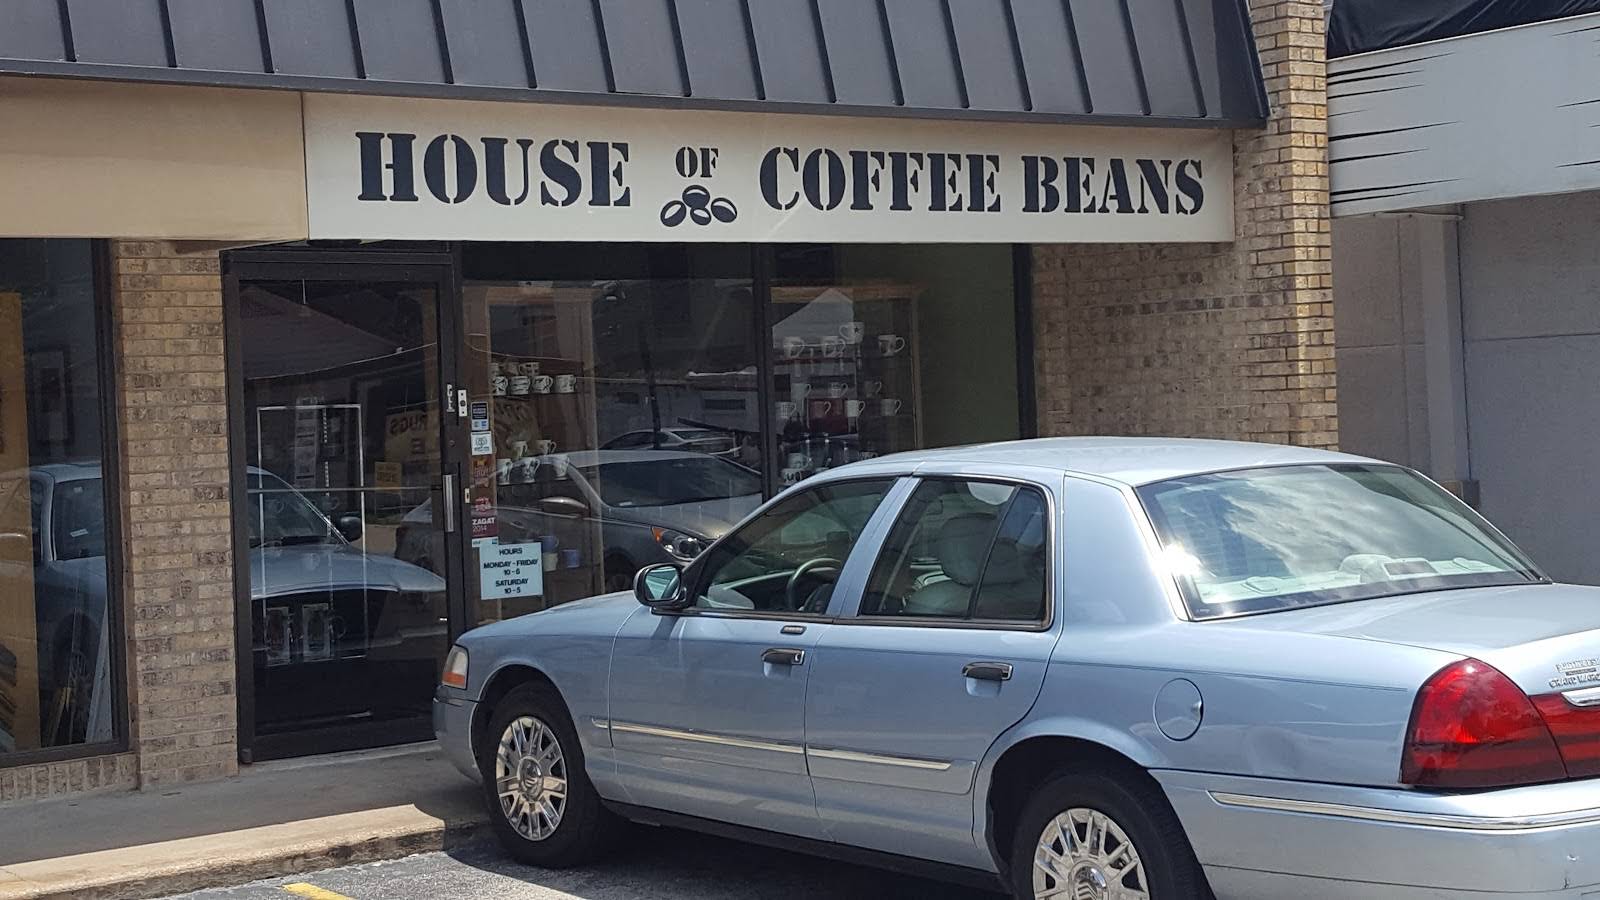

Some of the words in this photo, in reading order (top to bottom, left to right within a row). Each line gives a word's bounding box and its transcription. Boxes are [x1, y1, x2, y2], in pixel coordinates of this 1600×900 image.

[356, 131, 631, 207] HOUSE
[675, 146, 719, 178] OF
[759, 147, 1000, 211] COFFEE
[1021, 156, 1205, 215] BEANS
[499, 548, 523, 556] HOURS
[484, 561, 511, 569] MONDAY
[516, 559, 538, 567] FRIDAY
[496, 579, 528, 587] SATURDAY
